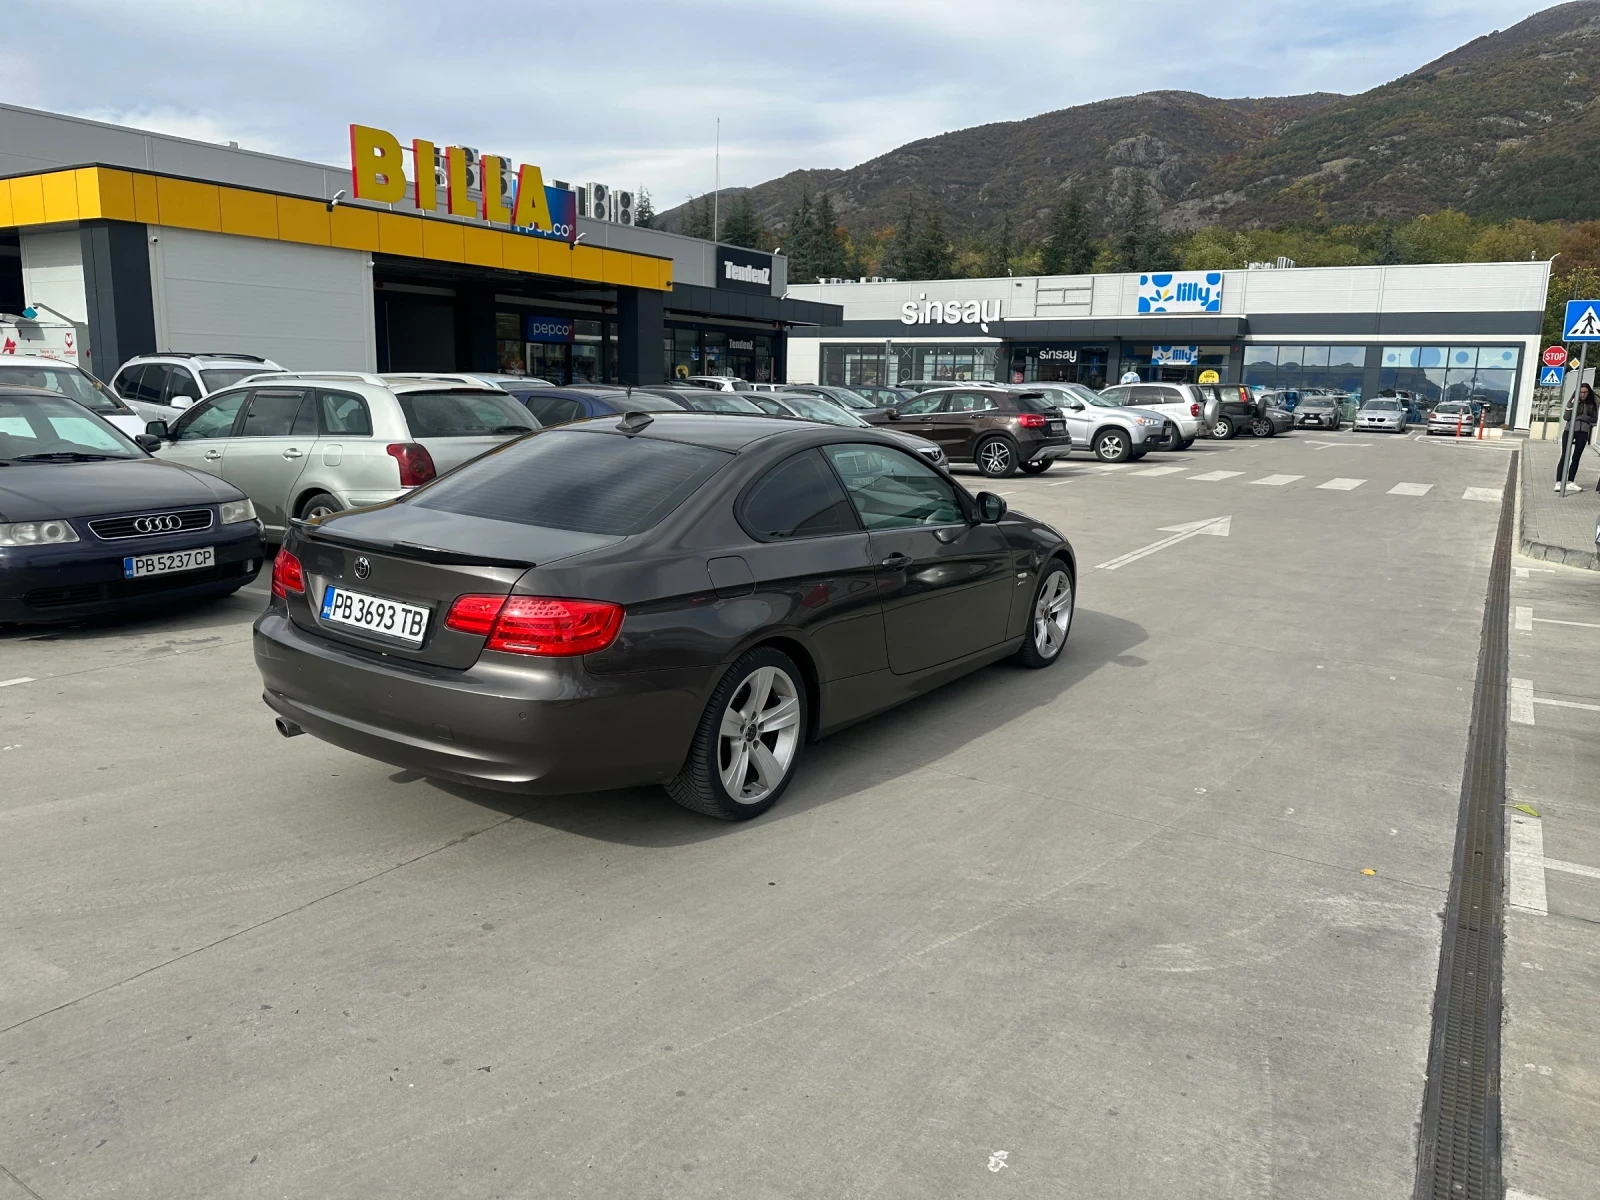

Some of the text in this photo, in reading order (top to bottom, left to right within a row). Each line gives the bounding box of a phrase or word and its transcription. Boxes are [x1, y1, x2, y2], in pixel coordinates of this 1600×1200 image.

[350, 124, 552, 231] BILLA
[724, 260, 770, 285] TendenZ
[1176, 282, 1211, 307] lilly
[900, 292, 1002, 333] sinsay
[533, 323, 570, 336] pepco
[1039, 347, 1077, 363] sinsay
[1172, 349, 1193, 363] lilly
[1545, 352, 1565, 361] STOP
[135, 550, 212, 574] PB 5237 CP
[323, 605, 331, 614] BG
[332, 592, 424, 637] PB 3693 TB
